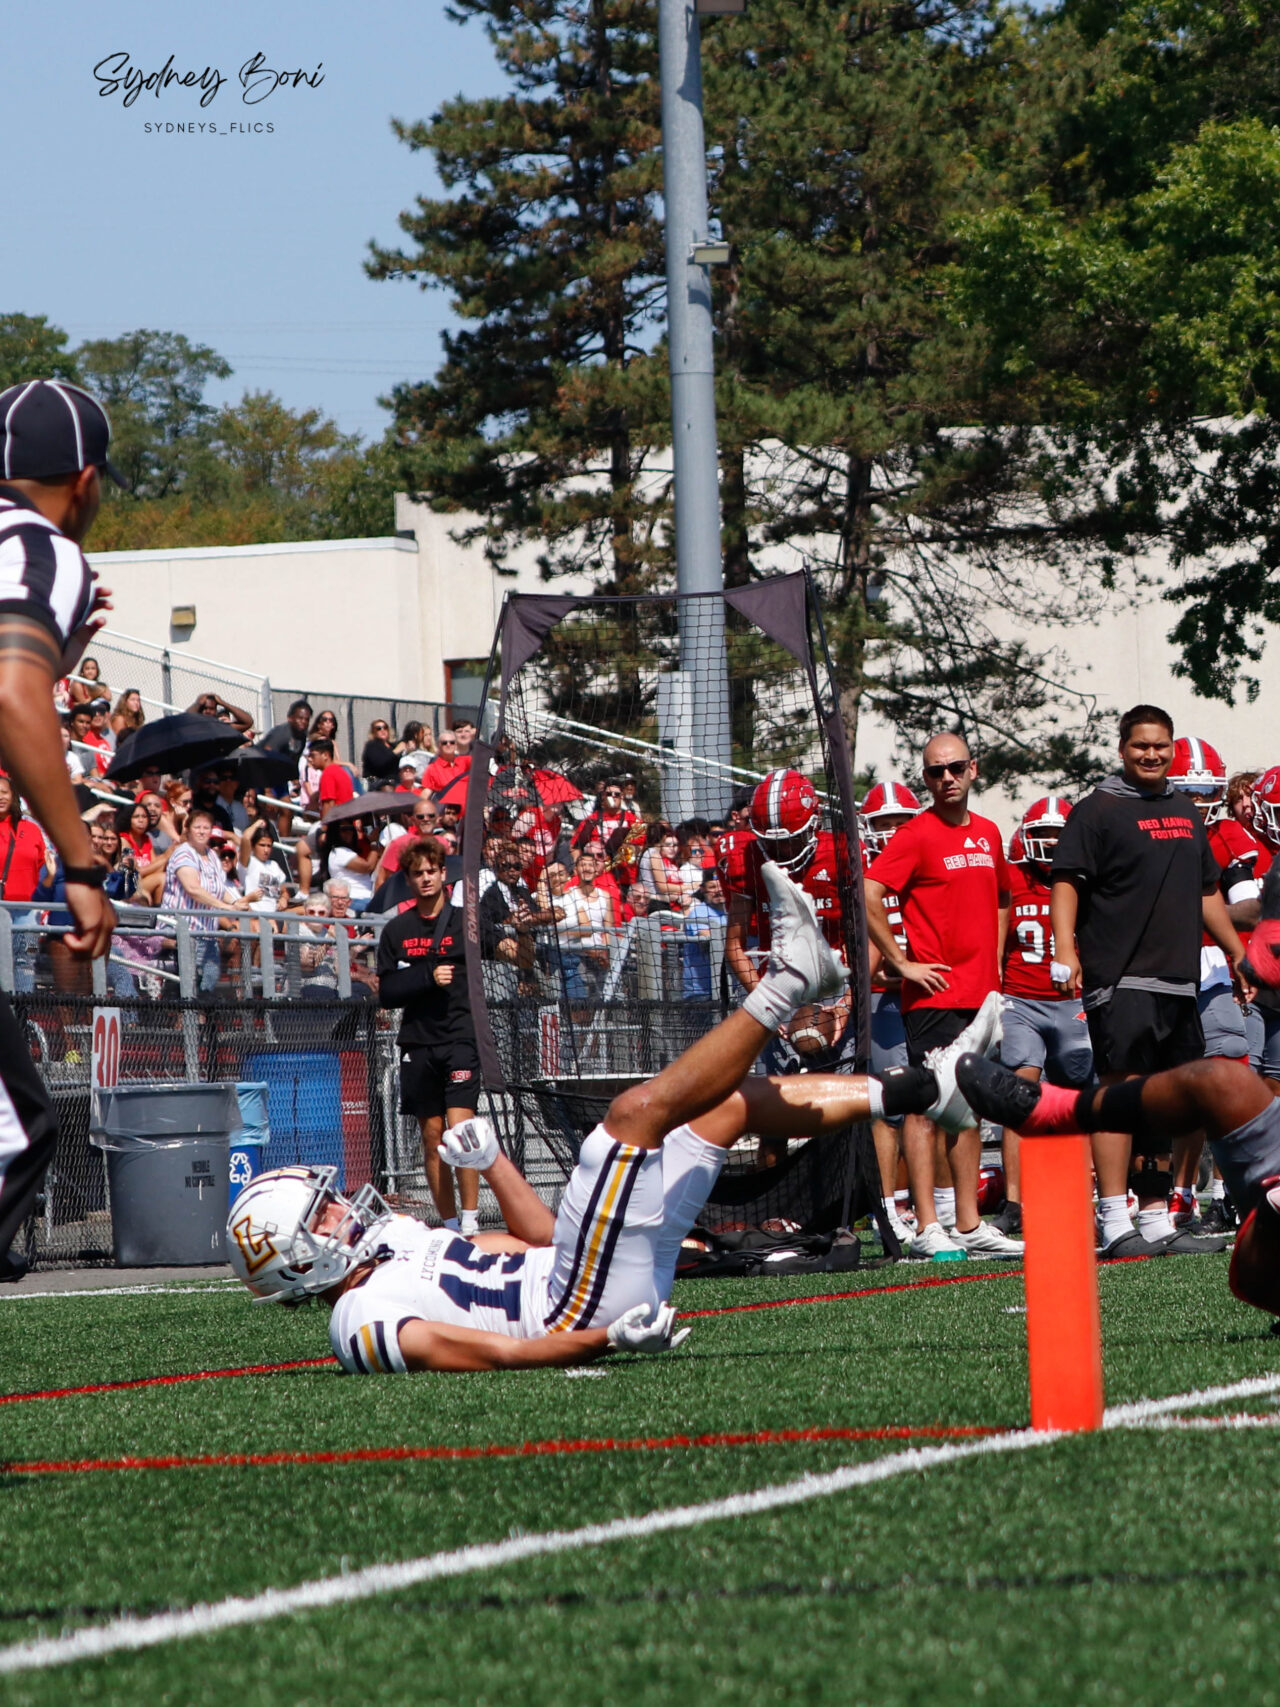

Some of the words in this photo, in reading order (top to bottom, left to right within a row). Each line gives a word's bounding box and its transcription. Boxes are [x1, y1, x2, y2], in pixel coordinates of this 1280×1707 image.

[1137, 819, 1161, 831] RED
[1164, 816, 1194, 829] HAWKS
[1150, 829, 1194, 840] FOOTBALL
[720, 835, 735, 853] 21
[943, 855, 967, 870] RED
[1015, 905, 1039, 917] RED
[438, 1237, 526, 1322] 15
